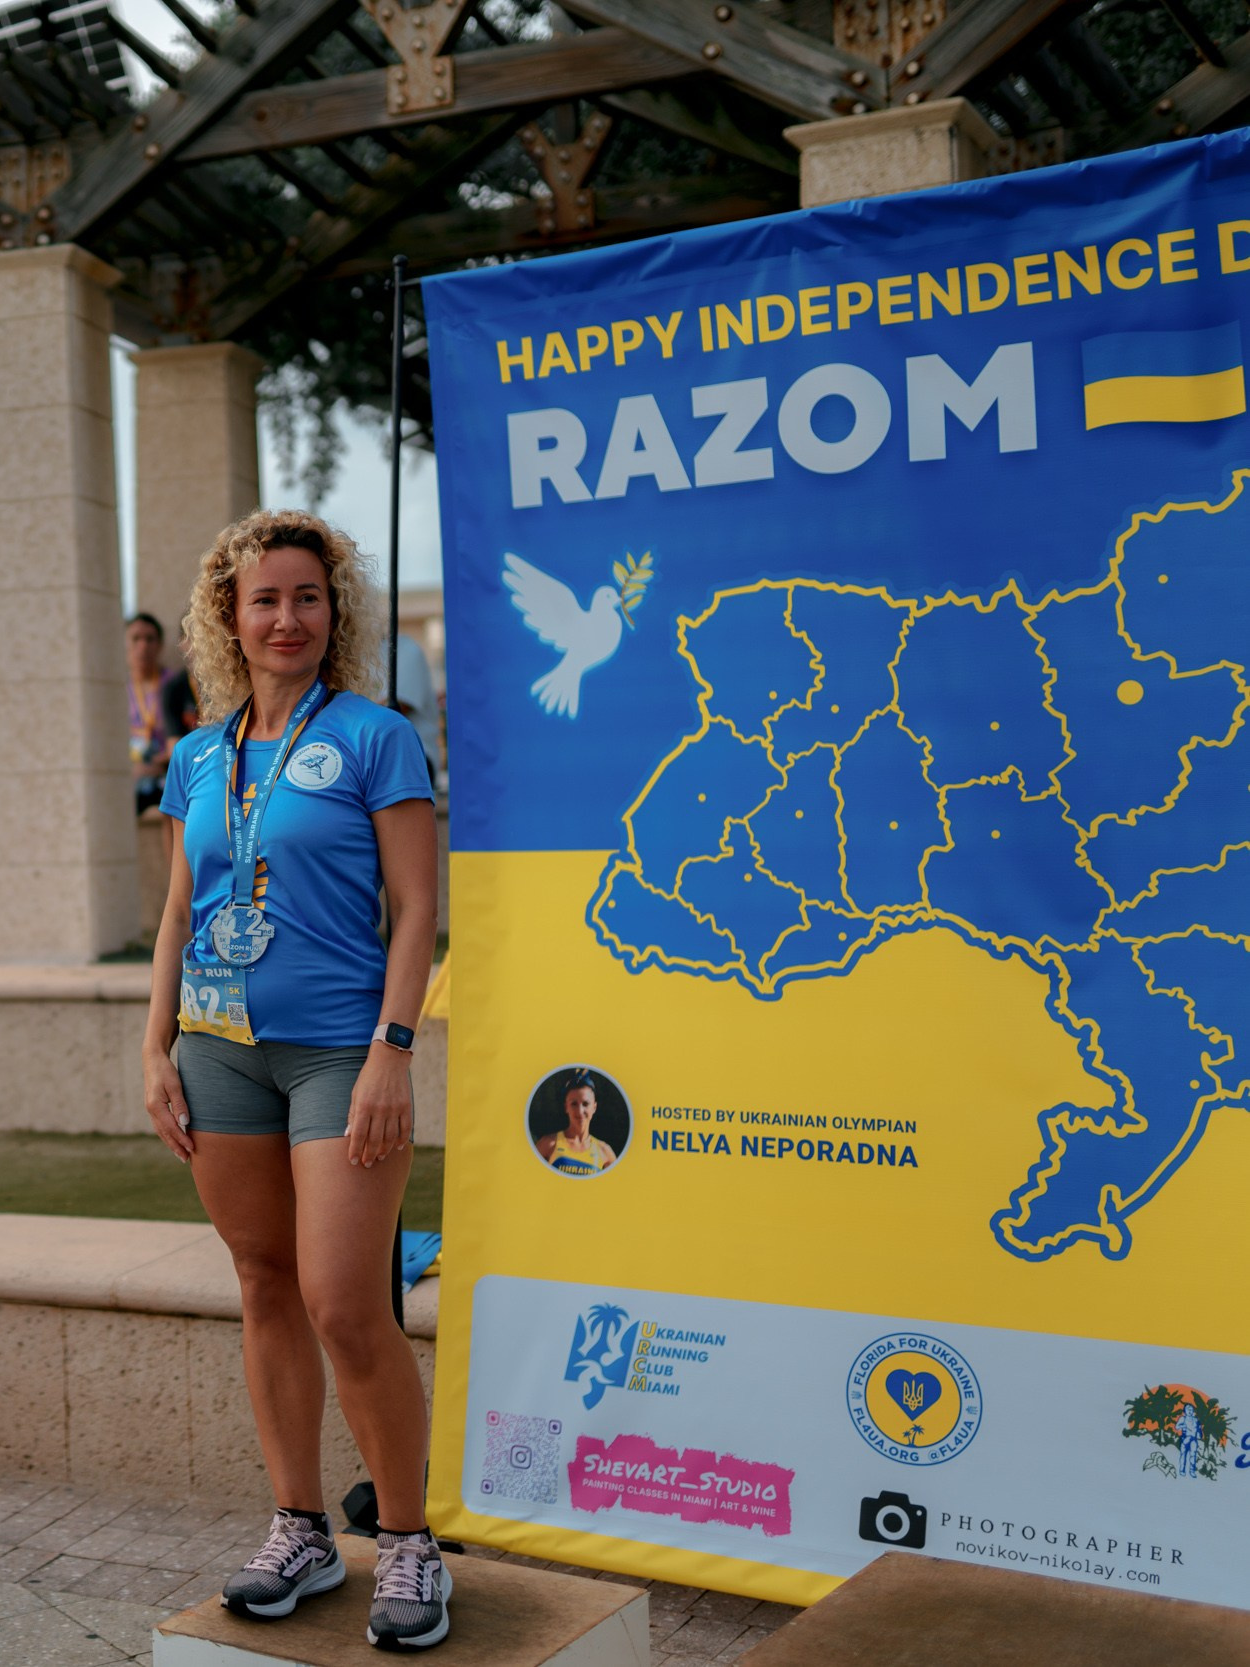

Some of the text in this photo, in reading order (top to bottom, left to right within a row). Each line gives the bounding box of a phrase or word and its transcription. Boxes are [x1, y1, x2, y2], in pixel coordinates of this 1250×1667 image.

[496, 311, 684, 384] HAPPY
[699, 228, 1199, 352] INDEPENDENCE
[507, 341, 1038, 509] RAZOM
[245, 840, 256, 863] SLAVA
[205, 968, 233, 978] RUN
[228, 987, 240, 995] 5K
[651, 1106, 917, 1134] HOSTED BY UKRAINIAN OLYMPIAN
[651, 1130, 919, 1168] NELYA NEPORADNA
[641, 1321, 726, 1346] UKRAINIAN
[633, 1357, 674, 1376] CLUB
[637, 1339, 709, 1363] RUNNING
[853, 1338, 975, 1399] FLORIDA FOR UKRAINE
[628, 1375, 680, 1396] MIAMI
[853, 1407, 975, 1462] FL4UA.ORG @FL4UA
[582, 1478, 625, 1493] PAINTING
[627, 1485, 669, 1500] CLASSES
[671, 1493, 681, 1501] IN
[683, 1494, 712, 1507] MIAMI
[720, 1501, 740, 1511] ART
[742, 1503, 749, 1513] &
[751, 1505, 777, 1517] WINE
[940, 1512, 1185, 1565] PHOTOGRAPHER
[955, 1540, 1161, 1585] novikov-nikolay.com
